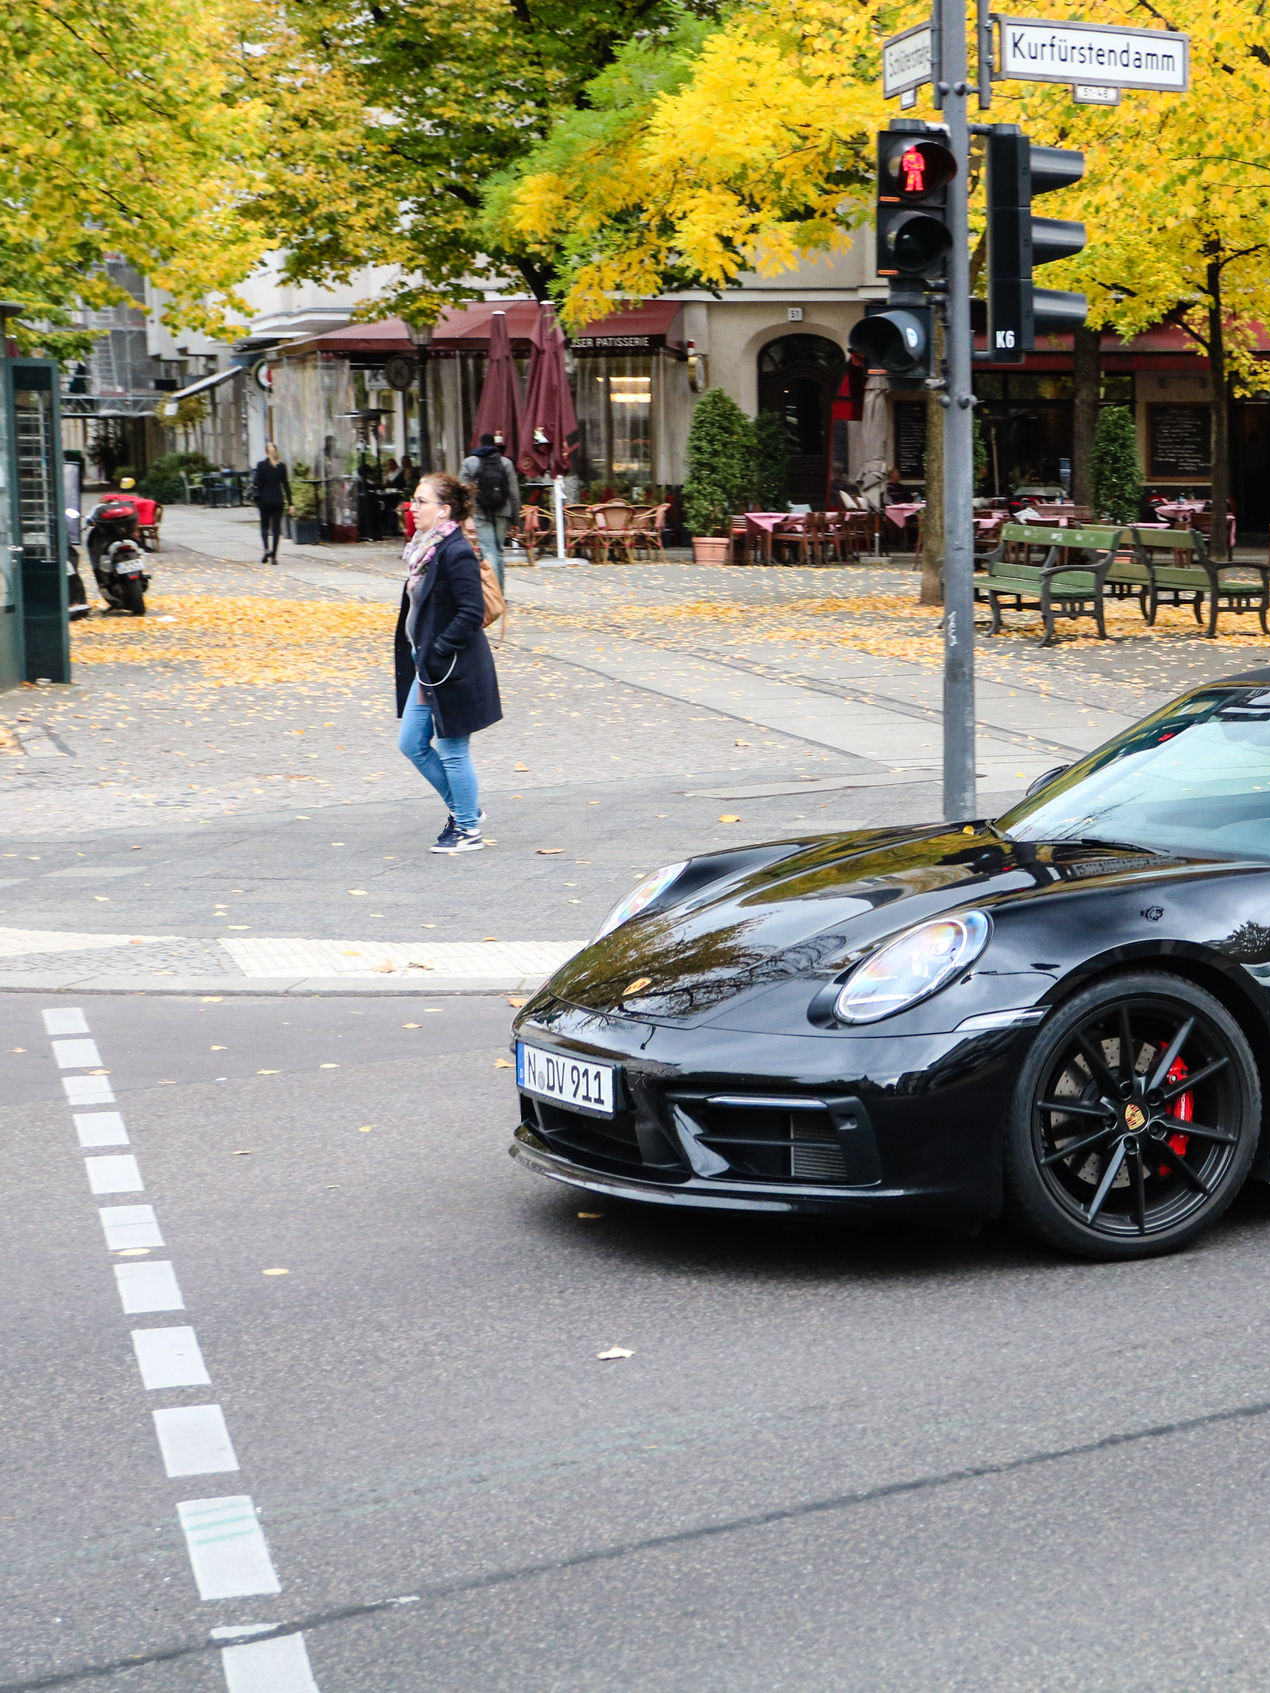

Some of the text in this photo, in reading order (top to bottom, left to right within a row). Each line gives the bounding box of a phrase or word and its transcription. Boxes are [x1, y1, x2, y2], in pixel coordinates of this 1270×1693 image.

[1012, 32, 1175, 72] Kurfürstendamm
[595, 337, 650, 347] PATISSERIE
[996, 330, 1015, 348] K6
[527, 1051, 537, 1086] N
[546, 1057, 566, 1095] DV
[570, 1065, 605, 1106] 911
